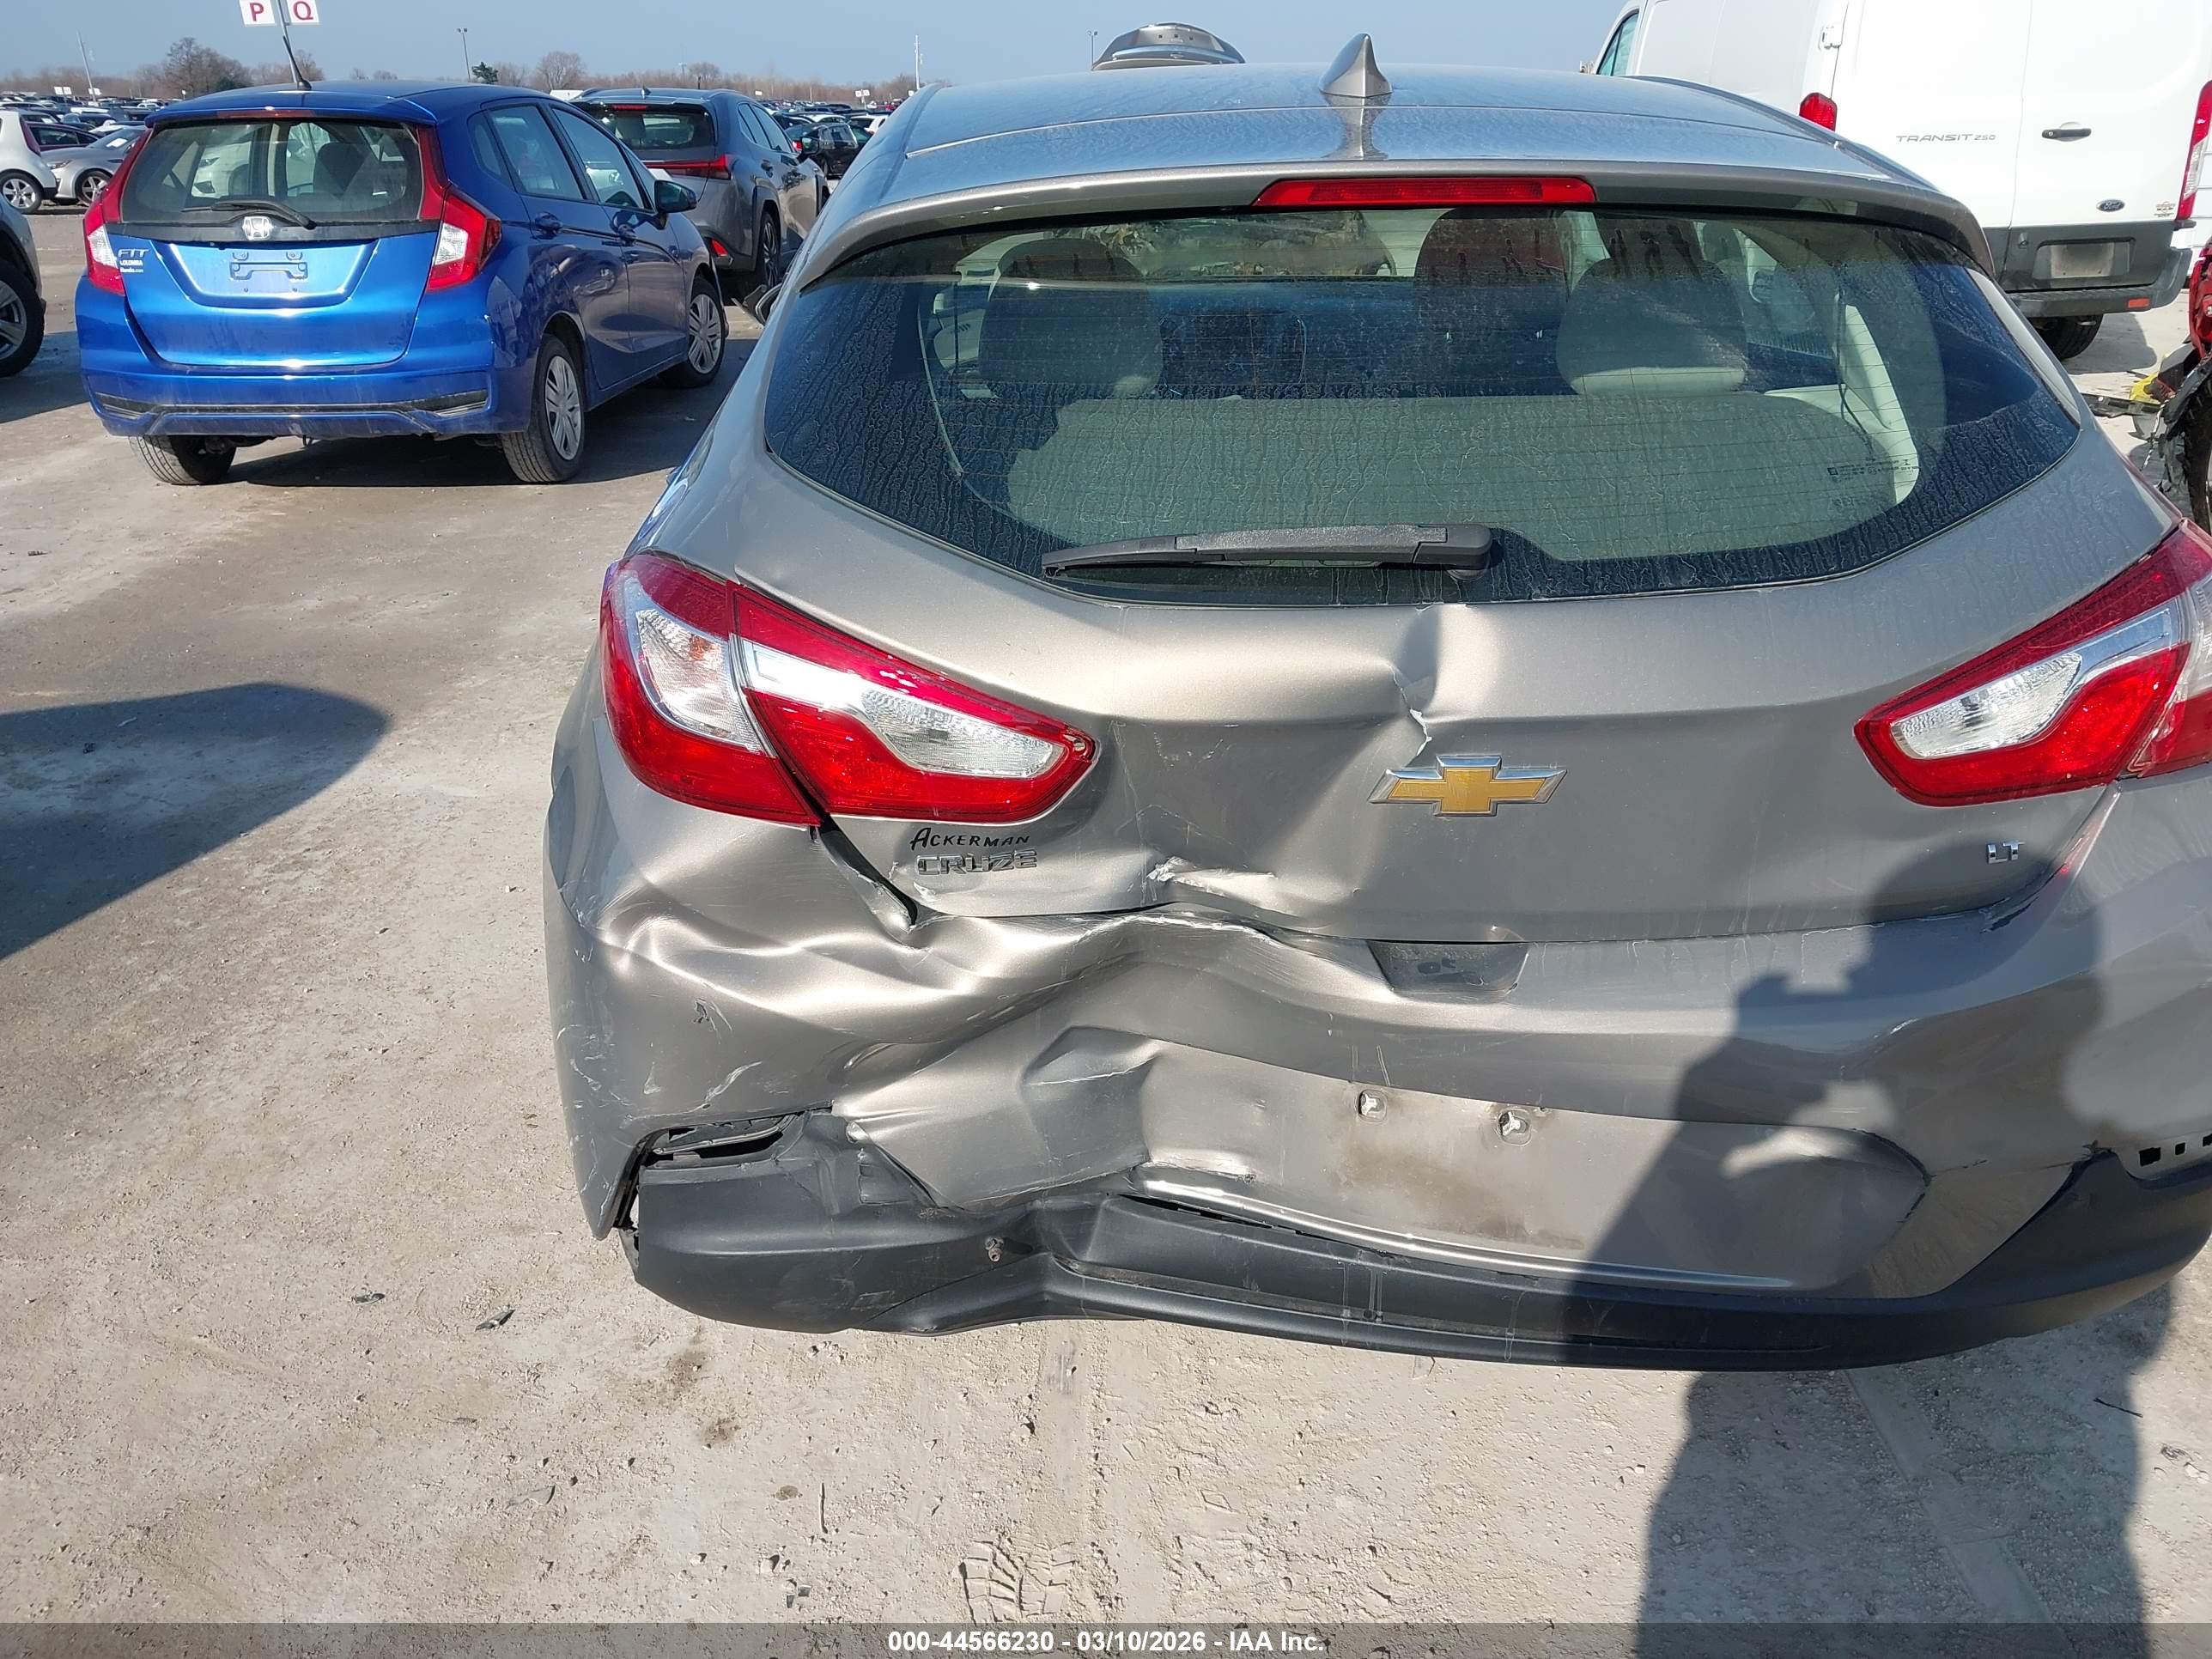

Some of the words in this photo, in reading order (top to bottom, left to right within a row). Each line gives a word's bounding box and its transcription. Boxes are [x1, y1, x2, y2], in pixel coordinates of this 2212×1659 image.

[249, 3, 264, 21] P
[293, 1, 314, 21] Q
[1895, 134, 1973, 143] TRANSIT
[118, 248, 150, 258] FIT
[909, 827, 1030, 851] ACKERMAN
[916, 848, 1037, 875] CRUZE
[1986, 840, 2026, 864] LT
